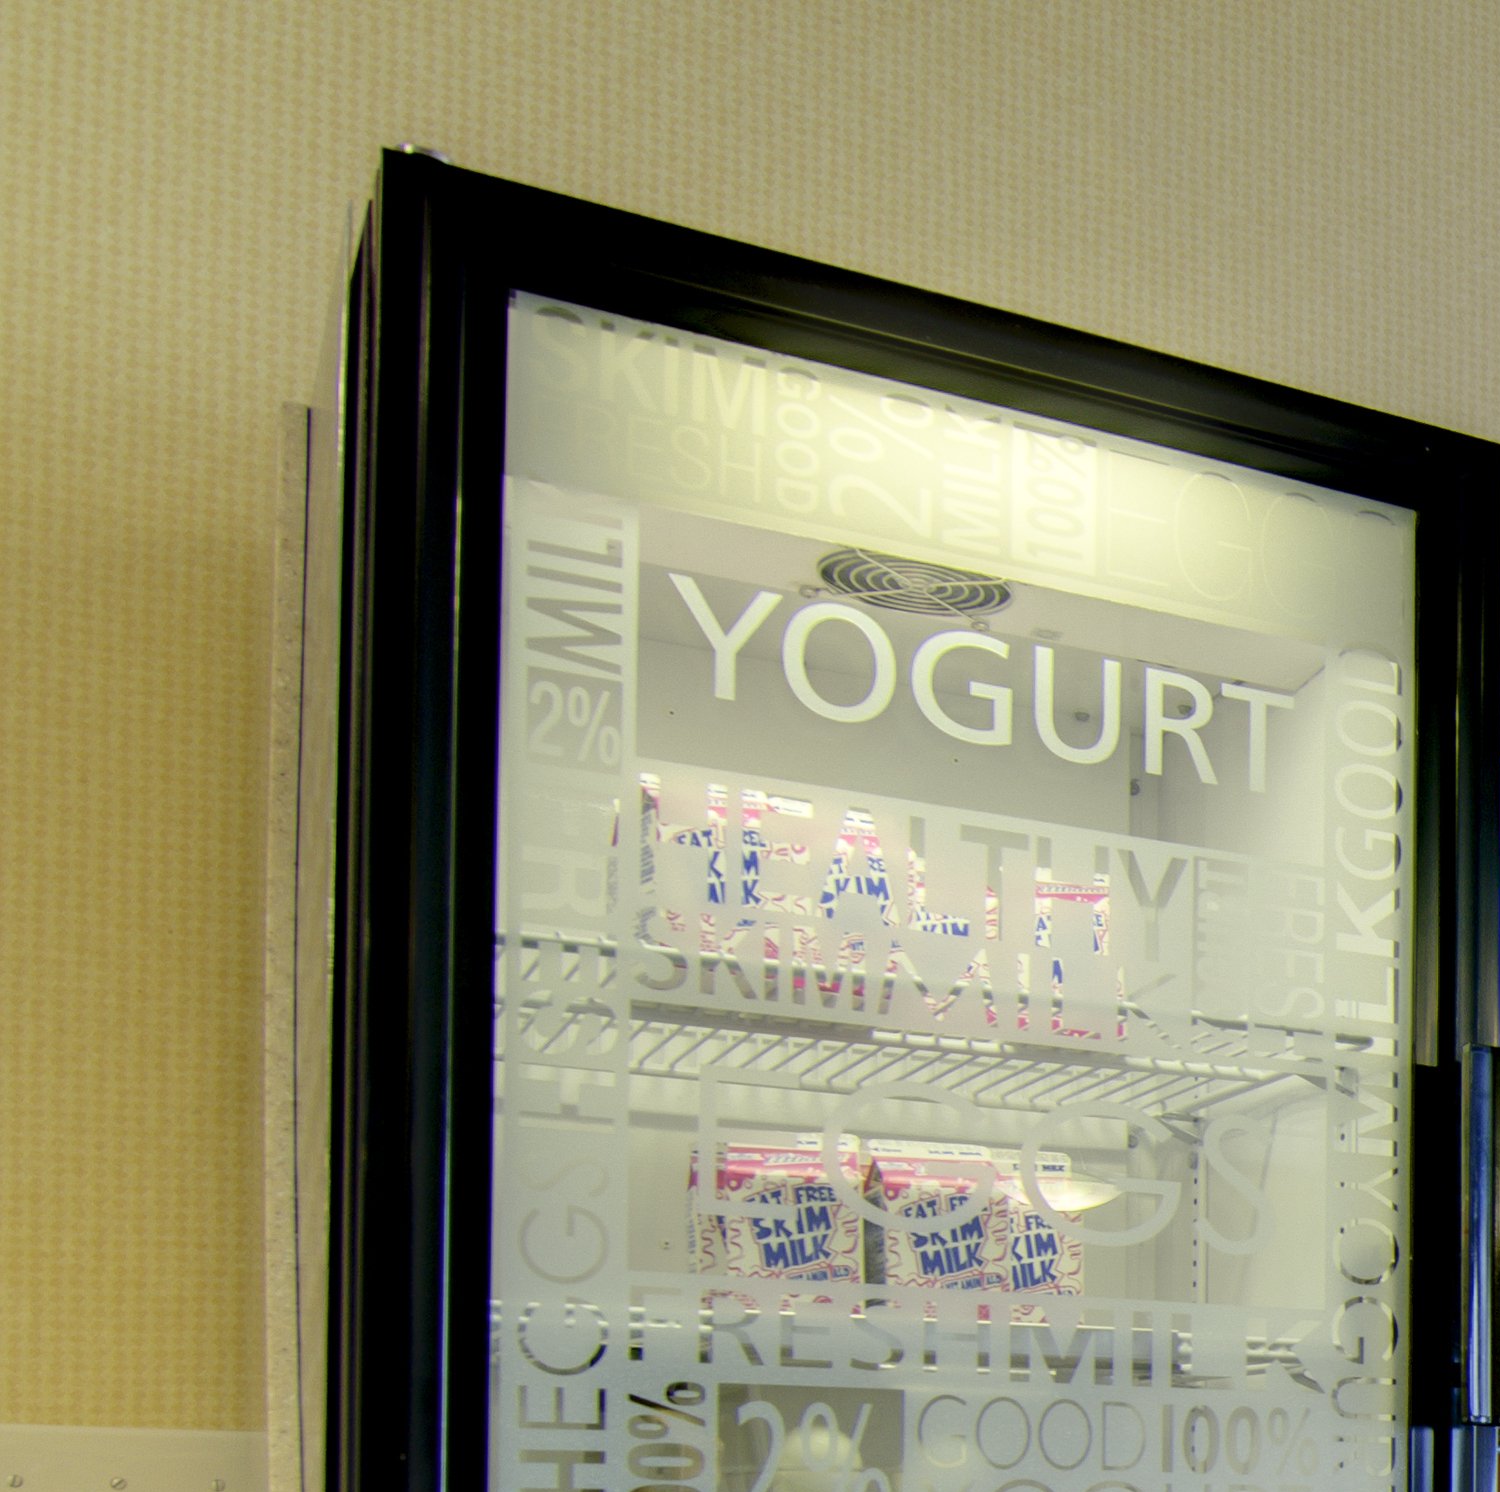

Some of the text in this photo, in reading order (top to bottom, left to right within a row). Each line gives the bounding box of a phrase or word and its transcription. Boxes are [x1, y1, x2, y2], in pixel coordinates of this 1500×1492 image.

[531, 305, 769, 437] SKIM
[527, 508, 623, 673] MIL
[528, 680, 622, 768] 2%
[667, 572, 1296, 795] YOGURT
[1335, 648, 1403, 881] GOOD
[640, 772, 1189, 963] HEALTHY
[752, 1205, 833, 1240] SKIM
[762, 1233, 832, 1269] MILK
[919, 1241, 984, 1276] MILK
[1011, 1231, 1059, 1262] KIM
[916, 1394, 1147, 1472] GOOD
[1160, 1403, 1318, 1477] 100%
